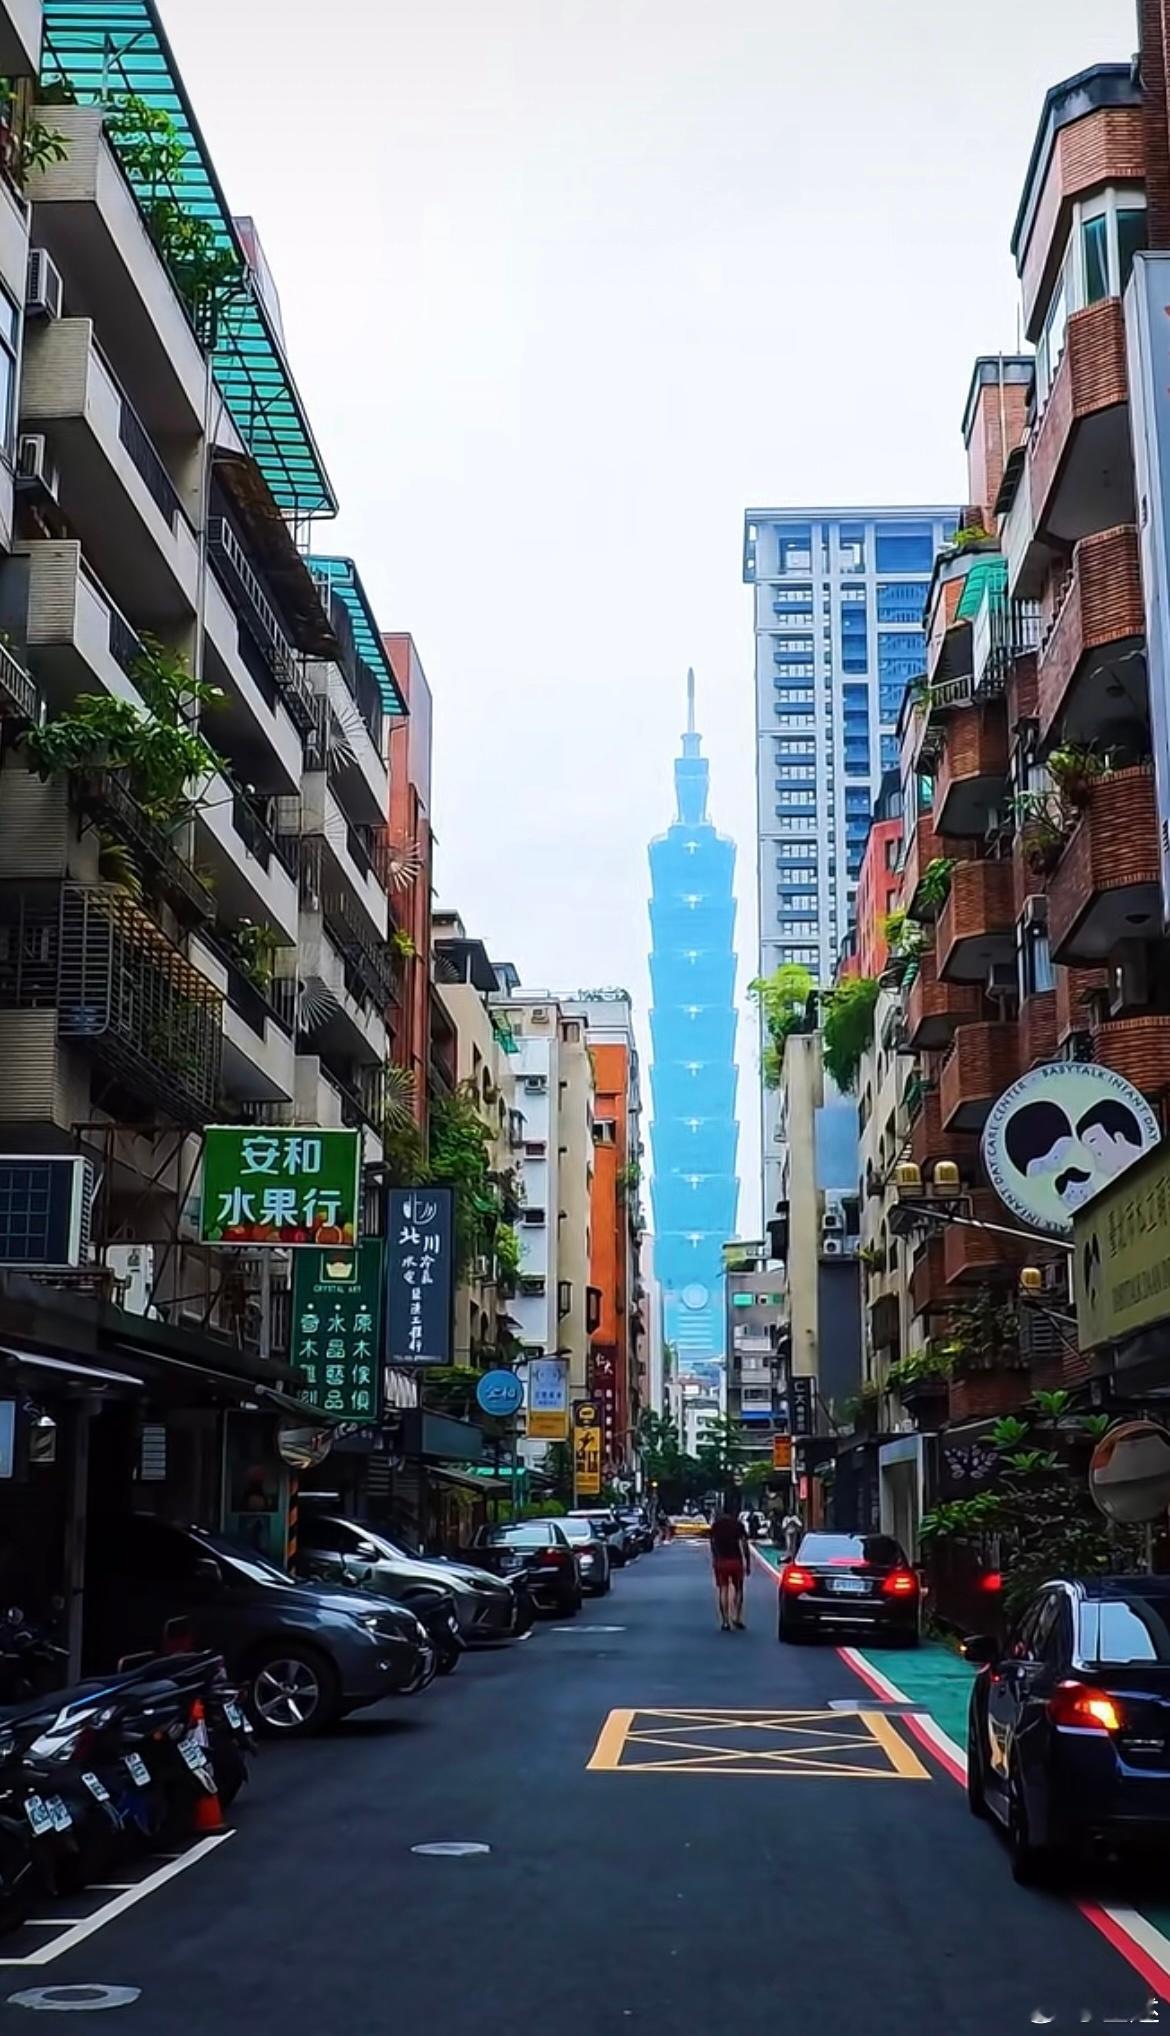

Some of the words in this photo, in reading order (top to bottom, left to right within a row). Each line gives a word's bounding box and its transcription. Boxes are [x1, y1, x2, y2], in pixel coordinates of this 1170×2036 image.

[994, 1082, 1029, 1121] CENTER
[1107, 1075, 1147, 1114] INFANT
[1143, 1117, 1159, 1141] DAY
[240, 1135, 321, 1175] 安和
[217, 1187, 341, 1228] 水果行
[313, 1285, 345, 1294] CRYSTAL
[347, 1285, 362, 1294] ART
